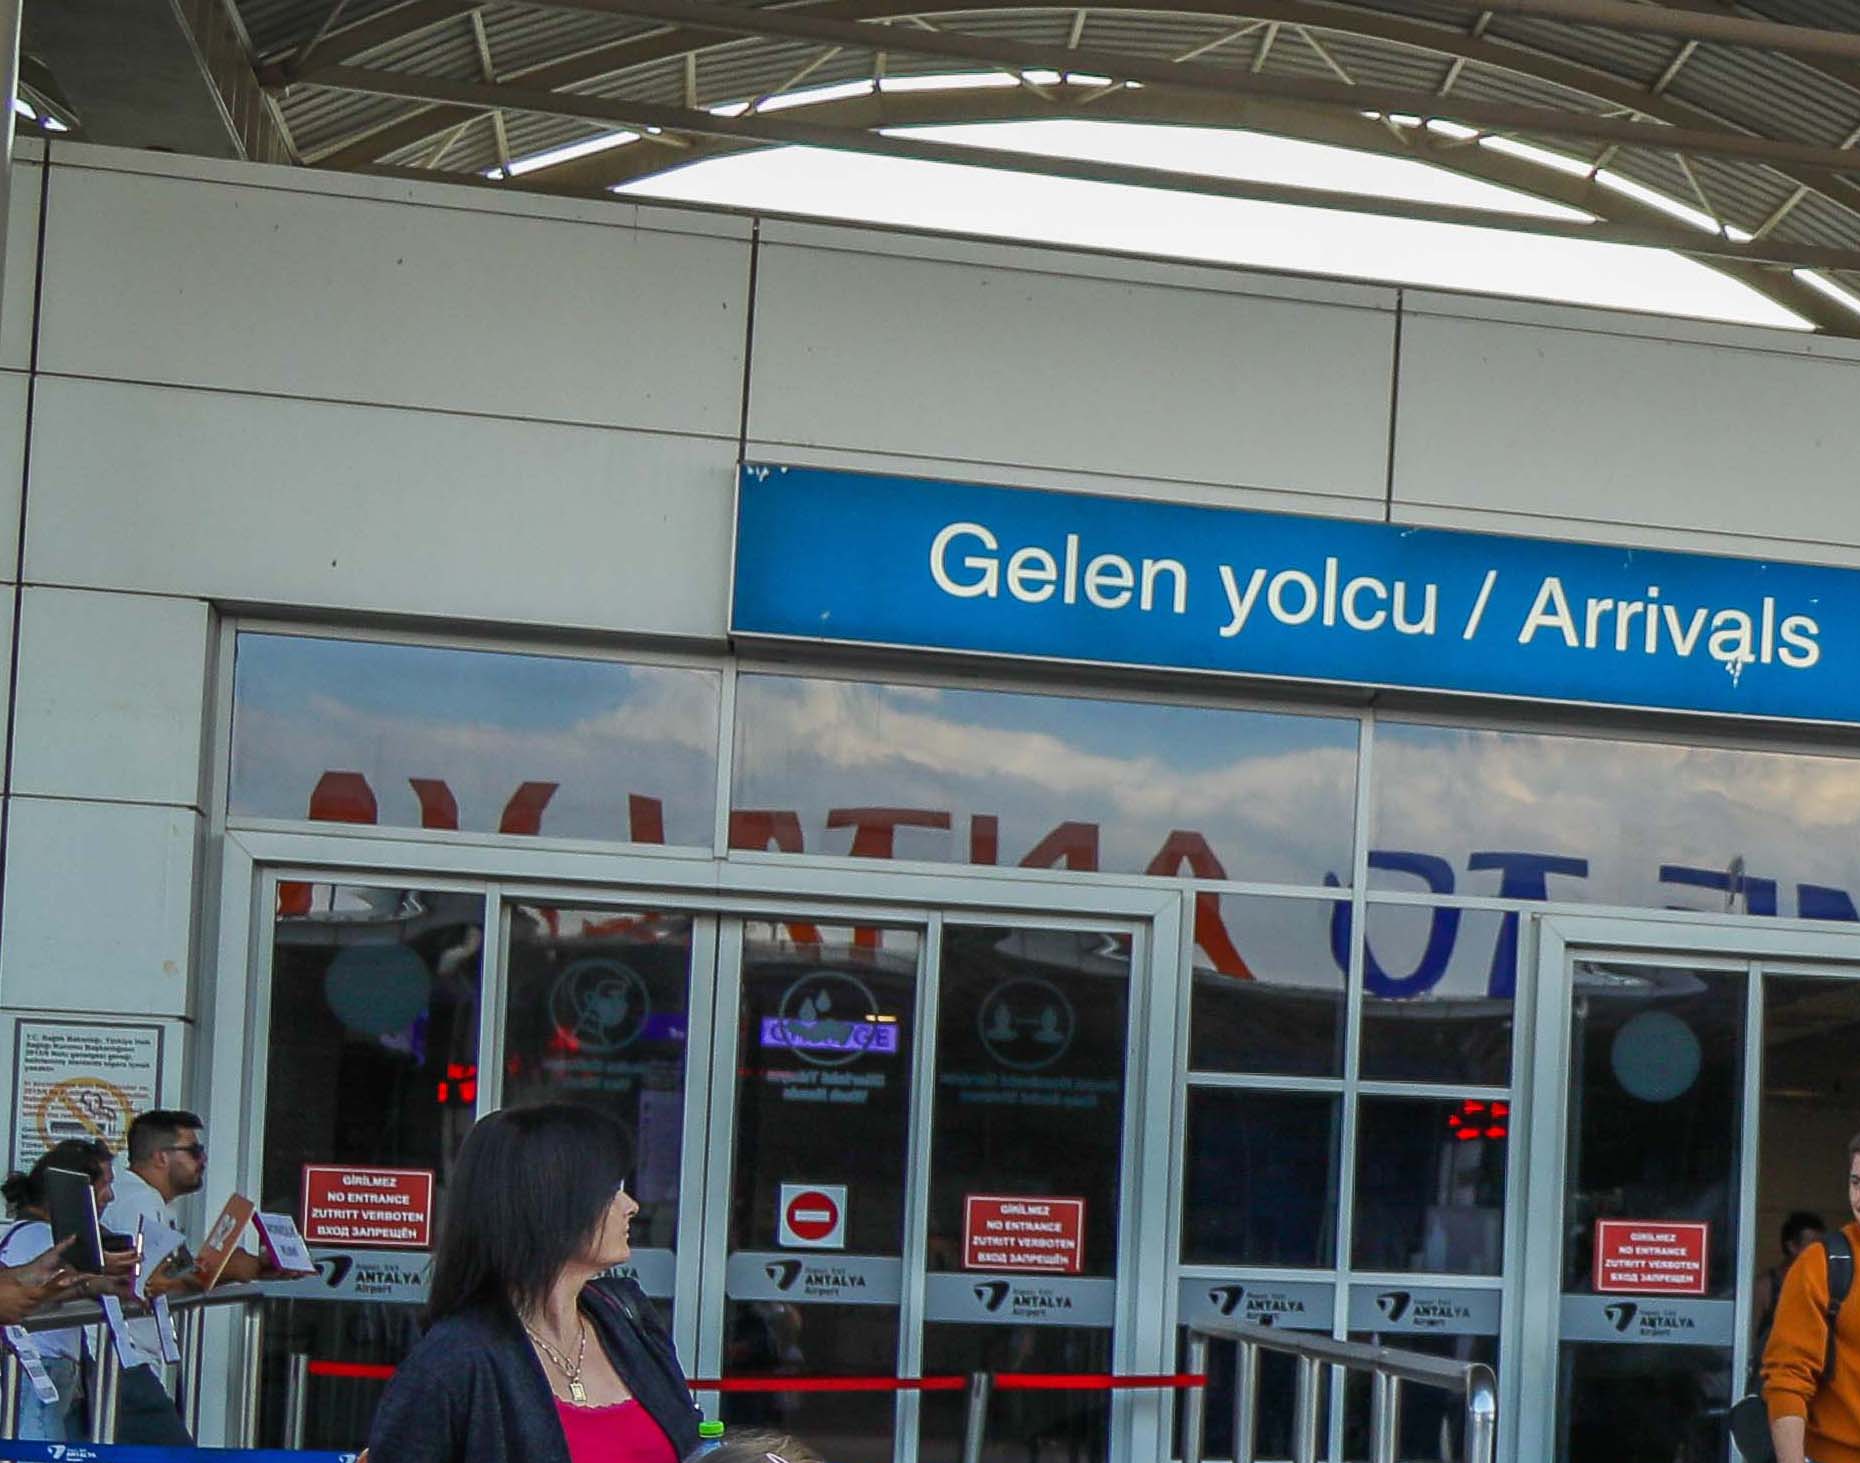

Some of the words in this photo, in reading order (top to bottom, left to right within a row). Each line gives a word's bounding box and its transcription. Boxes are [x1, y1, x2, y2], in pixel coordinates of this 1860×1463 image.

[931, 524, 1186, 612] Gelen
[1220, 558, 1436, 636] yolcu
[1464, 571, 1496, 639] /
[1519, 578, 1819, 669] Arrivals
[327, 1192, 345, 1202] NO
[347, 1193, 410, 1205] ENTRANCE
[312, 1208, 359, 1220] ZUTRITT
[362, 1210, 424, 1222] VERBOTEN
[986, 1220, 1003, 1231] NO
[1005, 1221, 1063, 1232] ENTRANCE
[355, 1272, 421, 1284] ANTALYA
[804, 1275, 866, 1288] ANTALYA
[1013, 1296, 1072, 1308] ANTALYA
[1246, 1300, 1305, 1313] ANTALYA
[1412, 1307, 1471, 1318] ANTALYA
[1640, 1317, 1695, 1329] ANTALYA
